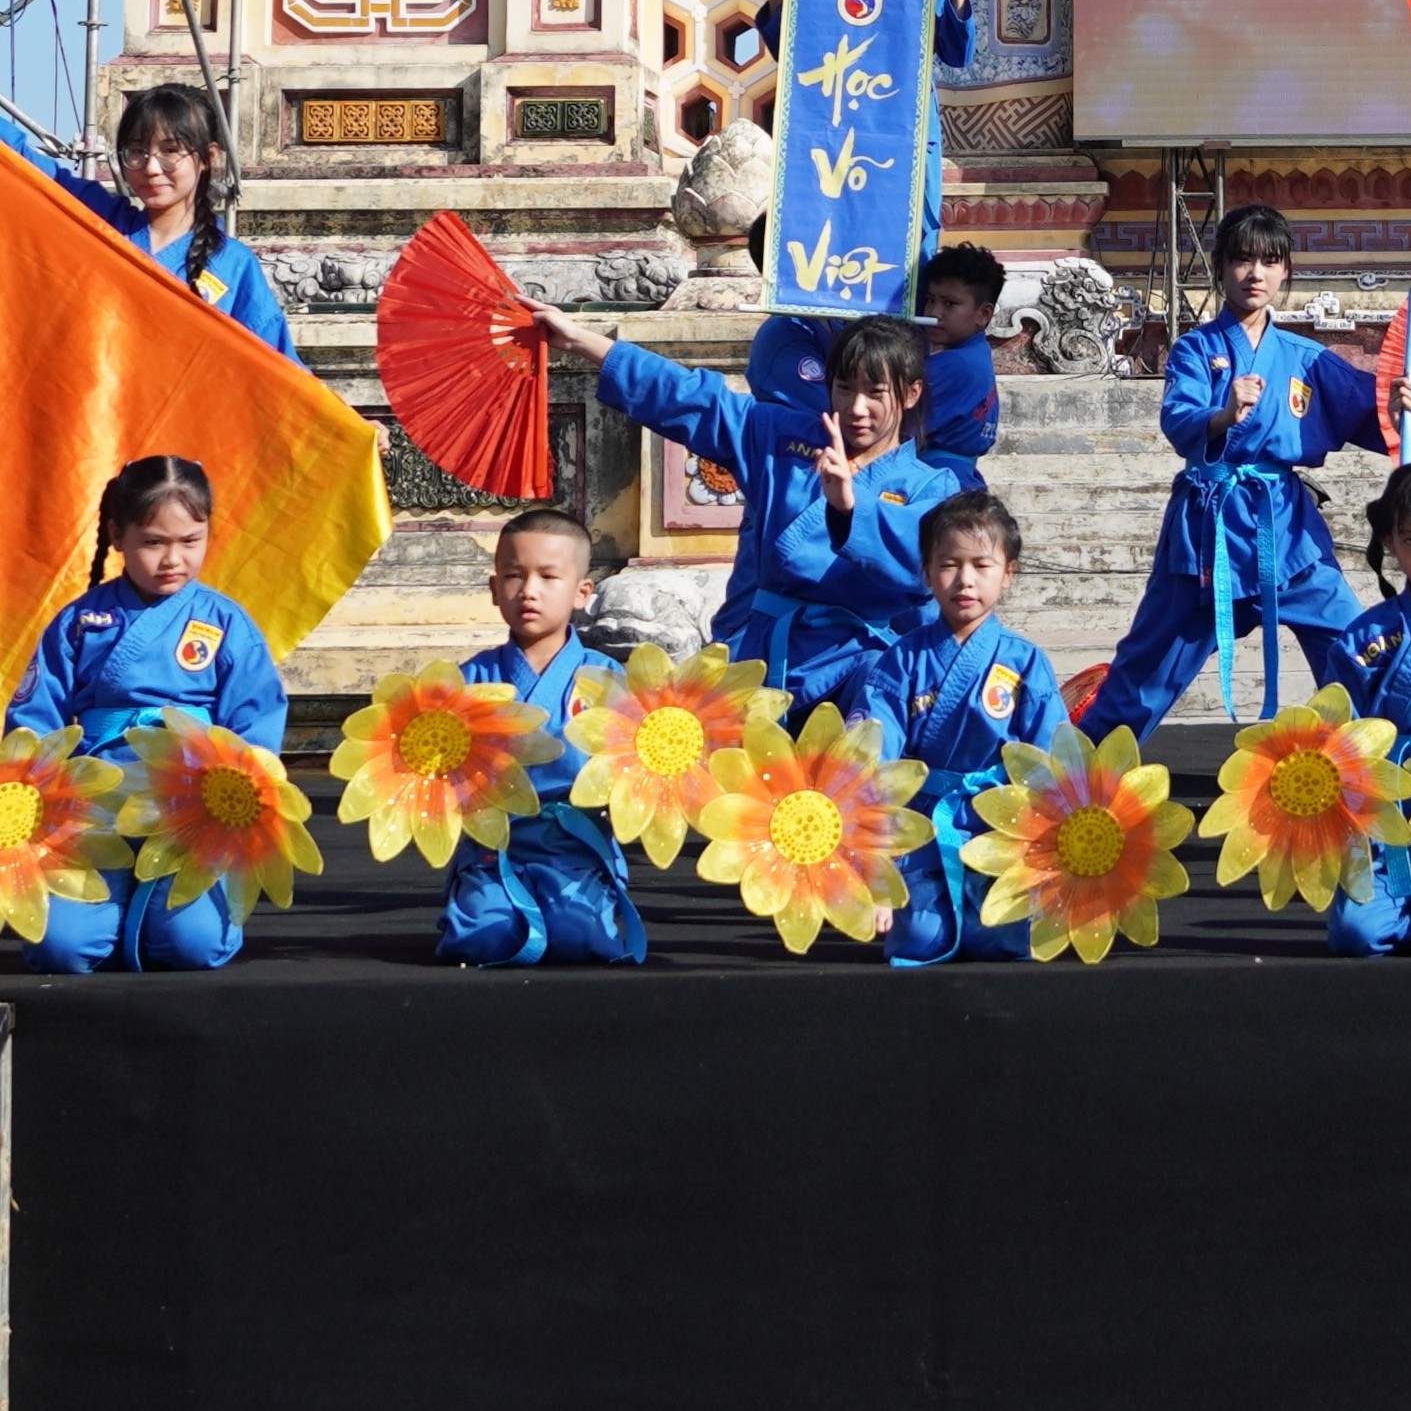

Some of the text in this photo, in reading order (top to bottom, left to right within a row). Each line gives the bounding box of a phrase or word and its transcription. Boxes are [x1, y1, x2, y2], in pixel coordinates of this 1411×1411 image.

[797, 32, 900, 127] Học
[811, 126, 894, 198] Võ
[787, 213, 899, 303] Việt
